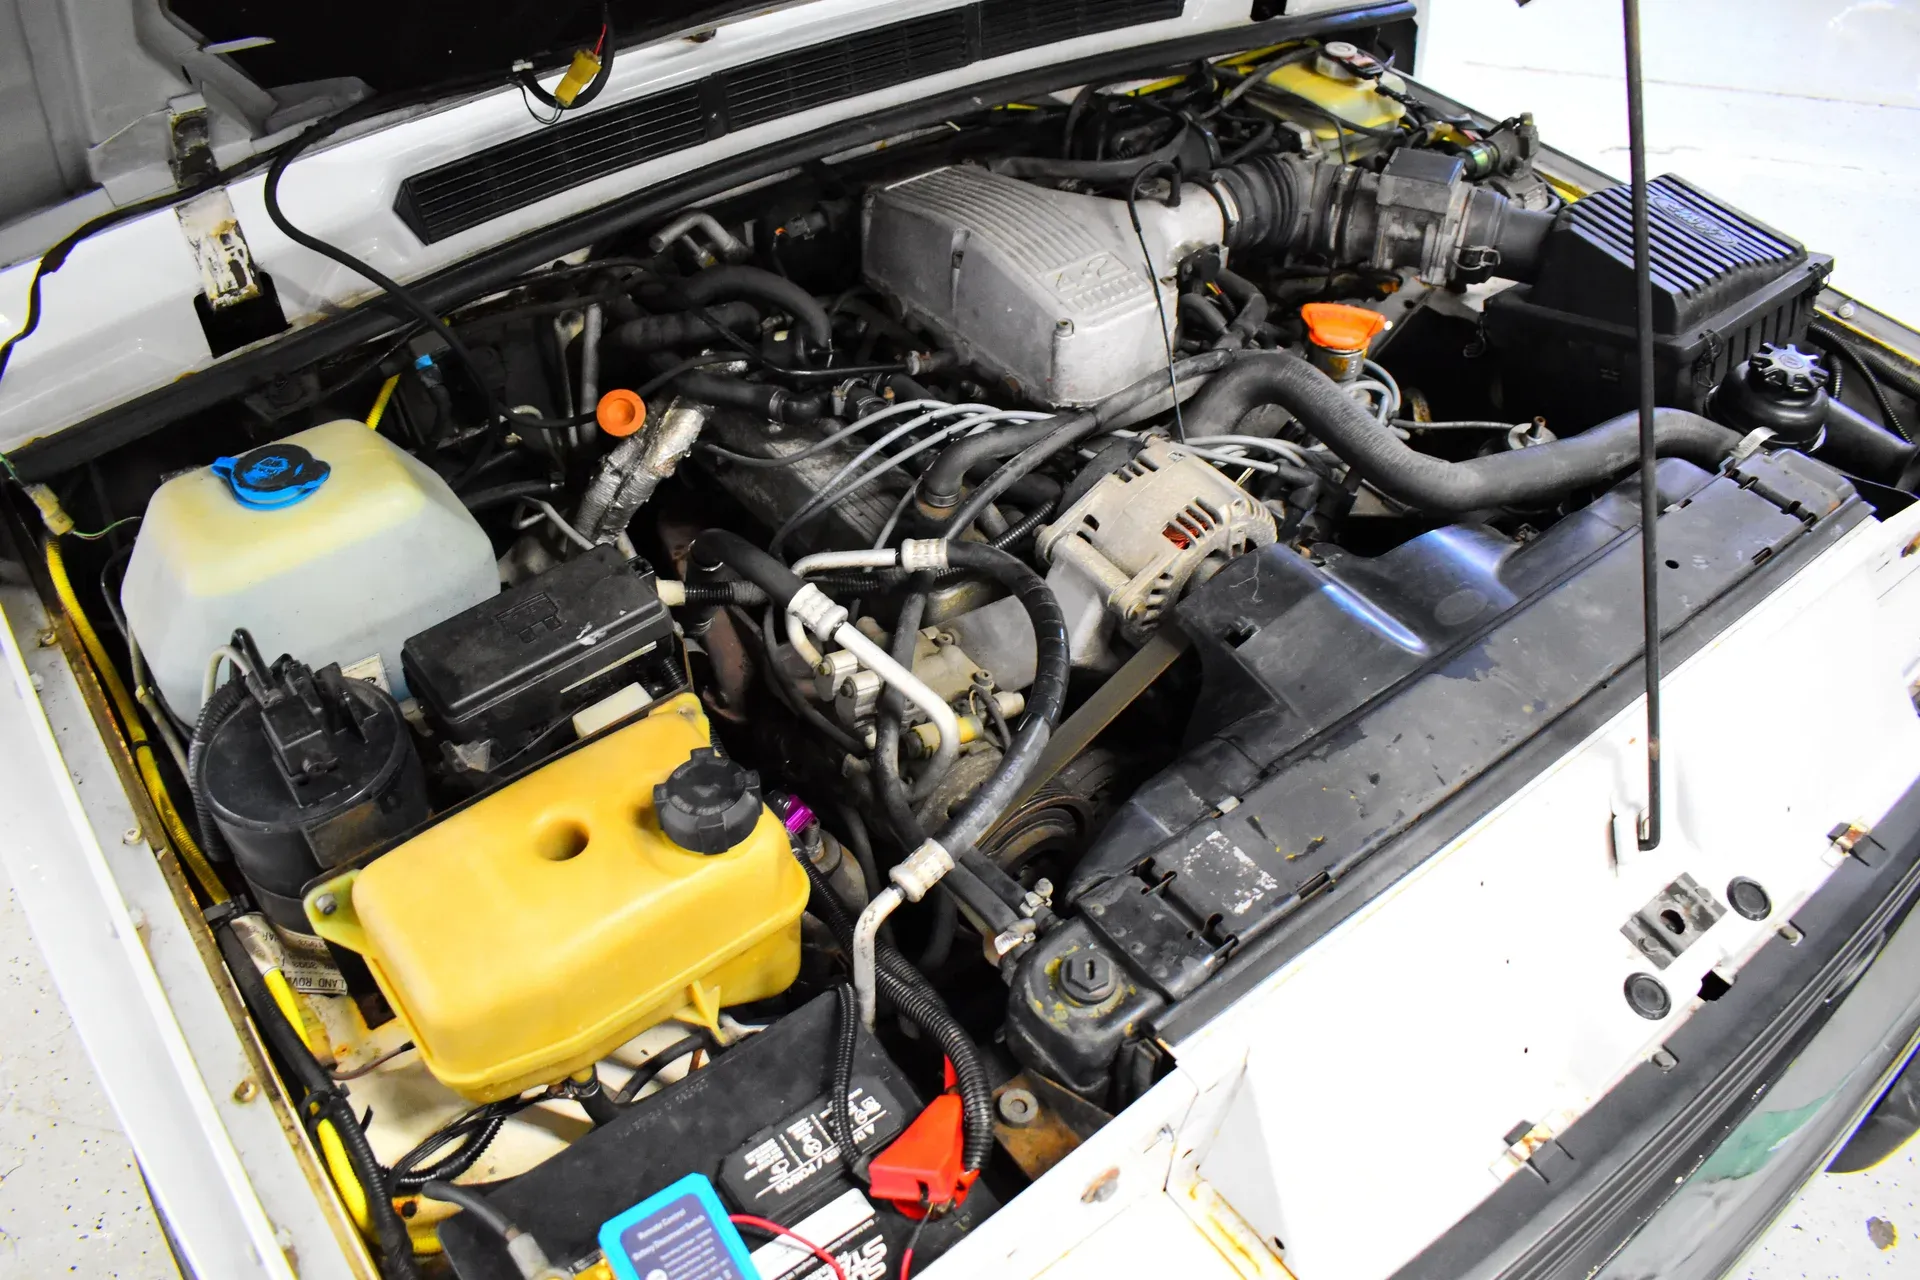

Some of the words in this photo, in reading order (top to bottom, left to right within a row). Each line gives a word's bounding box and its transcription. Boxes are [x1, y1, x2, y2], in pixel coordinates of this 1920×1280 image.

[318, 977, 345, 989] LAND
[774, 1163, 817, 1194] POISON
[661, 1207, 687, 1228] Control
